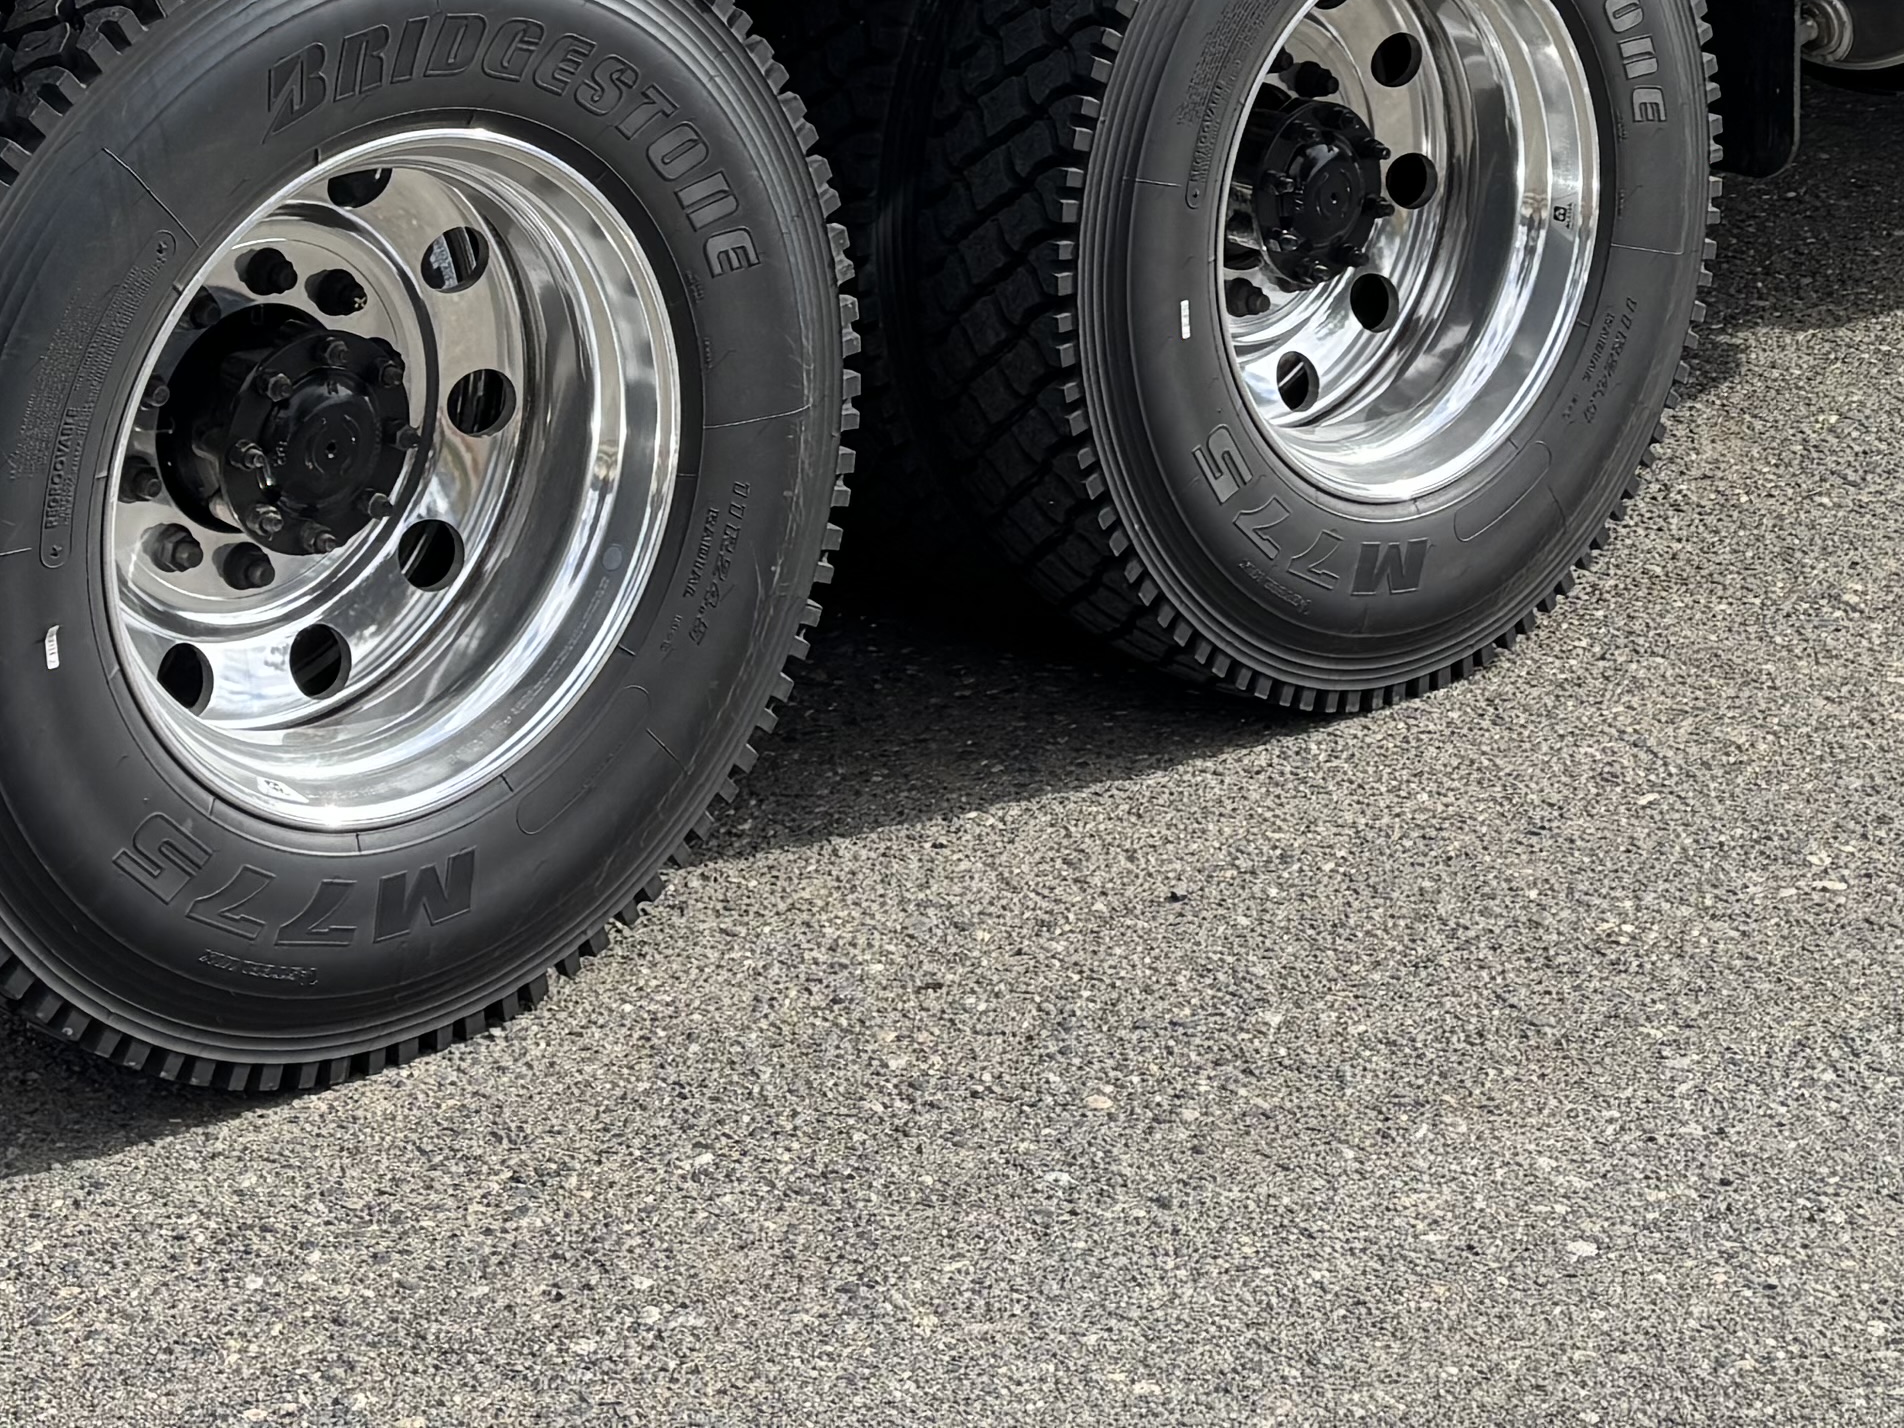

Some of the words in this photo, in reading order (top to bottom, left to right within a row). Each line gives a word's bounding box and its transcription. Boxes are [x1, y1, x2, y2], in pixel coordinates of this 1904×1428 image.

[262, 12, 761, 279] BRIDGESTONE
[1191, 423, 1429, 596] M775
[111, 811, 477, 946] M775
